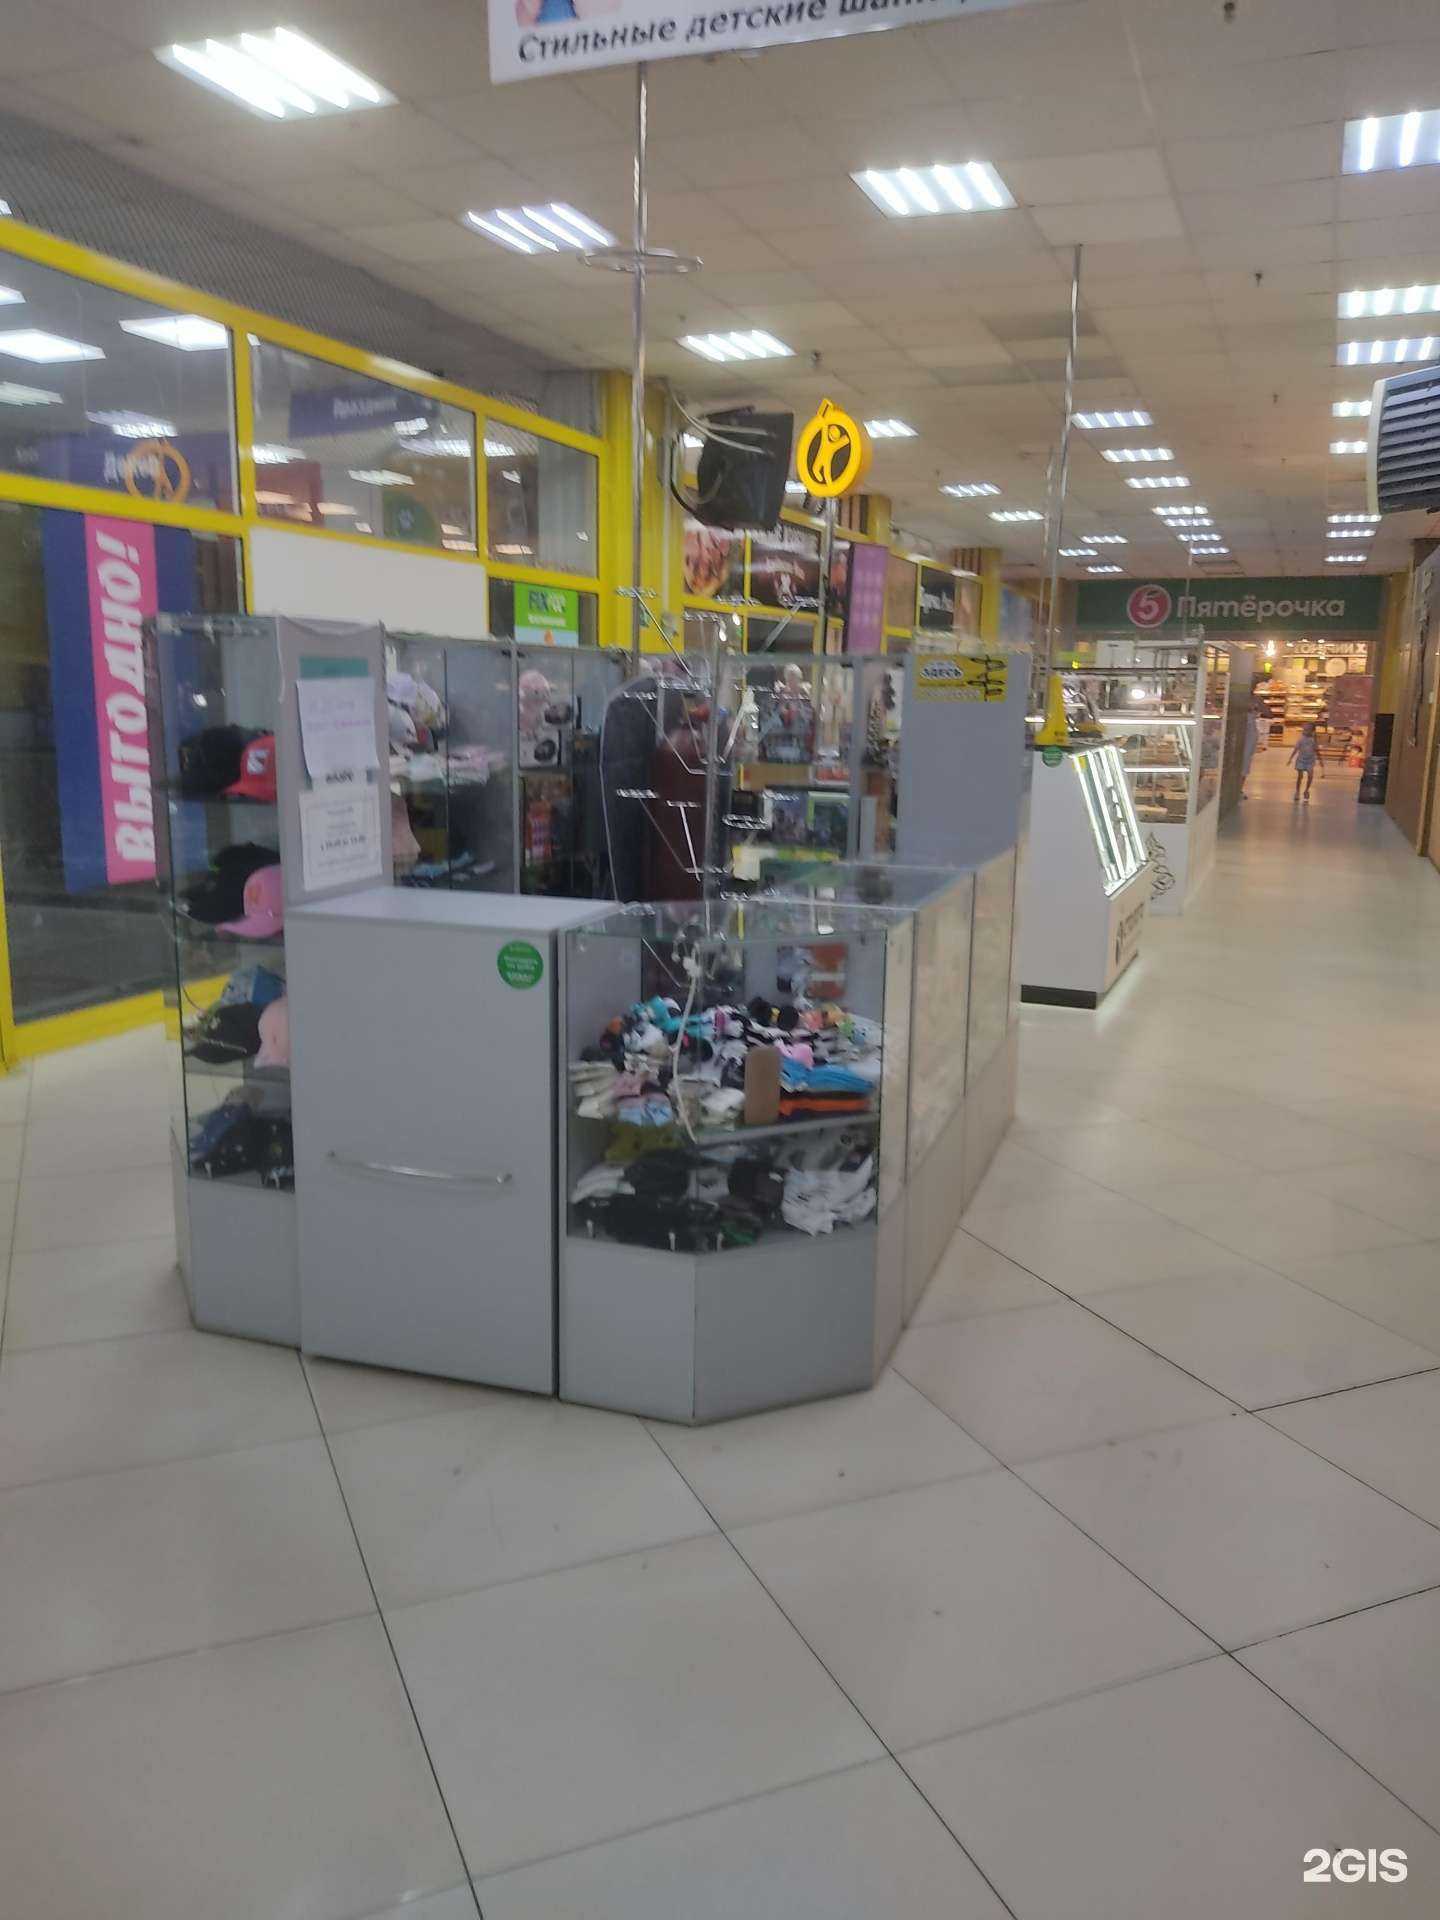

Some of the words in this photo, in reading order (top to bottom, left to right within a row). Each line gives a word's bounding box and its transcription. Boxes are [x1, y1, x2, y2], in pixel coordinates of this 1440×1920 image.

[518, 19, 677, 63] Стильные
[685, 0, 827, 43] детские
[1177, 596, 1345, 622] Пятёрочка
[96, 529, 156, 863] ВЫГОДНО!
